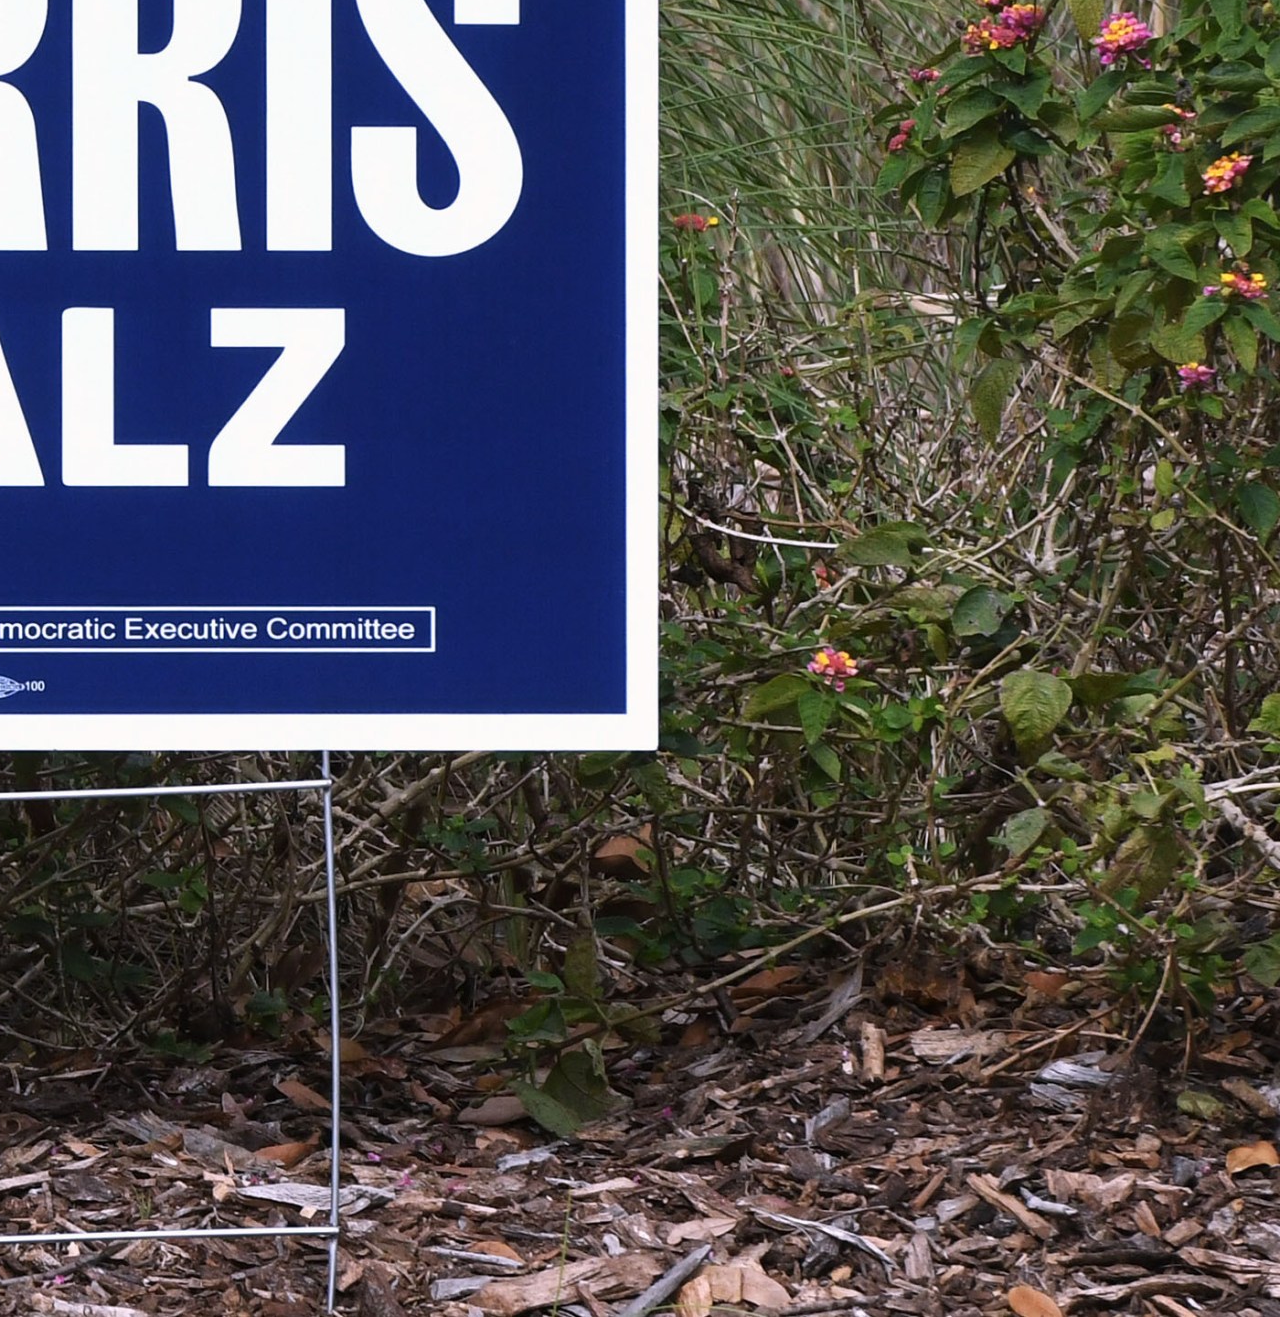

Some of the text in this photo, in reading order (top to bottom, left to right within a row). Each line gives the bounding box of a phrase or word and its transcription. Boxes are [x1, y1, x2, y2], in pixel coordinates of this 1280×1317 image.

[126, 618, 257, 639] Executive
[267, 618, 414, 639] Committee
[25, 681, 45, 692] 100
